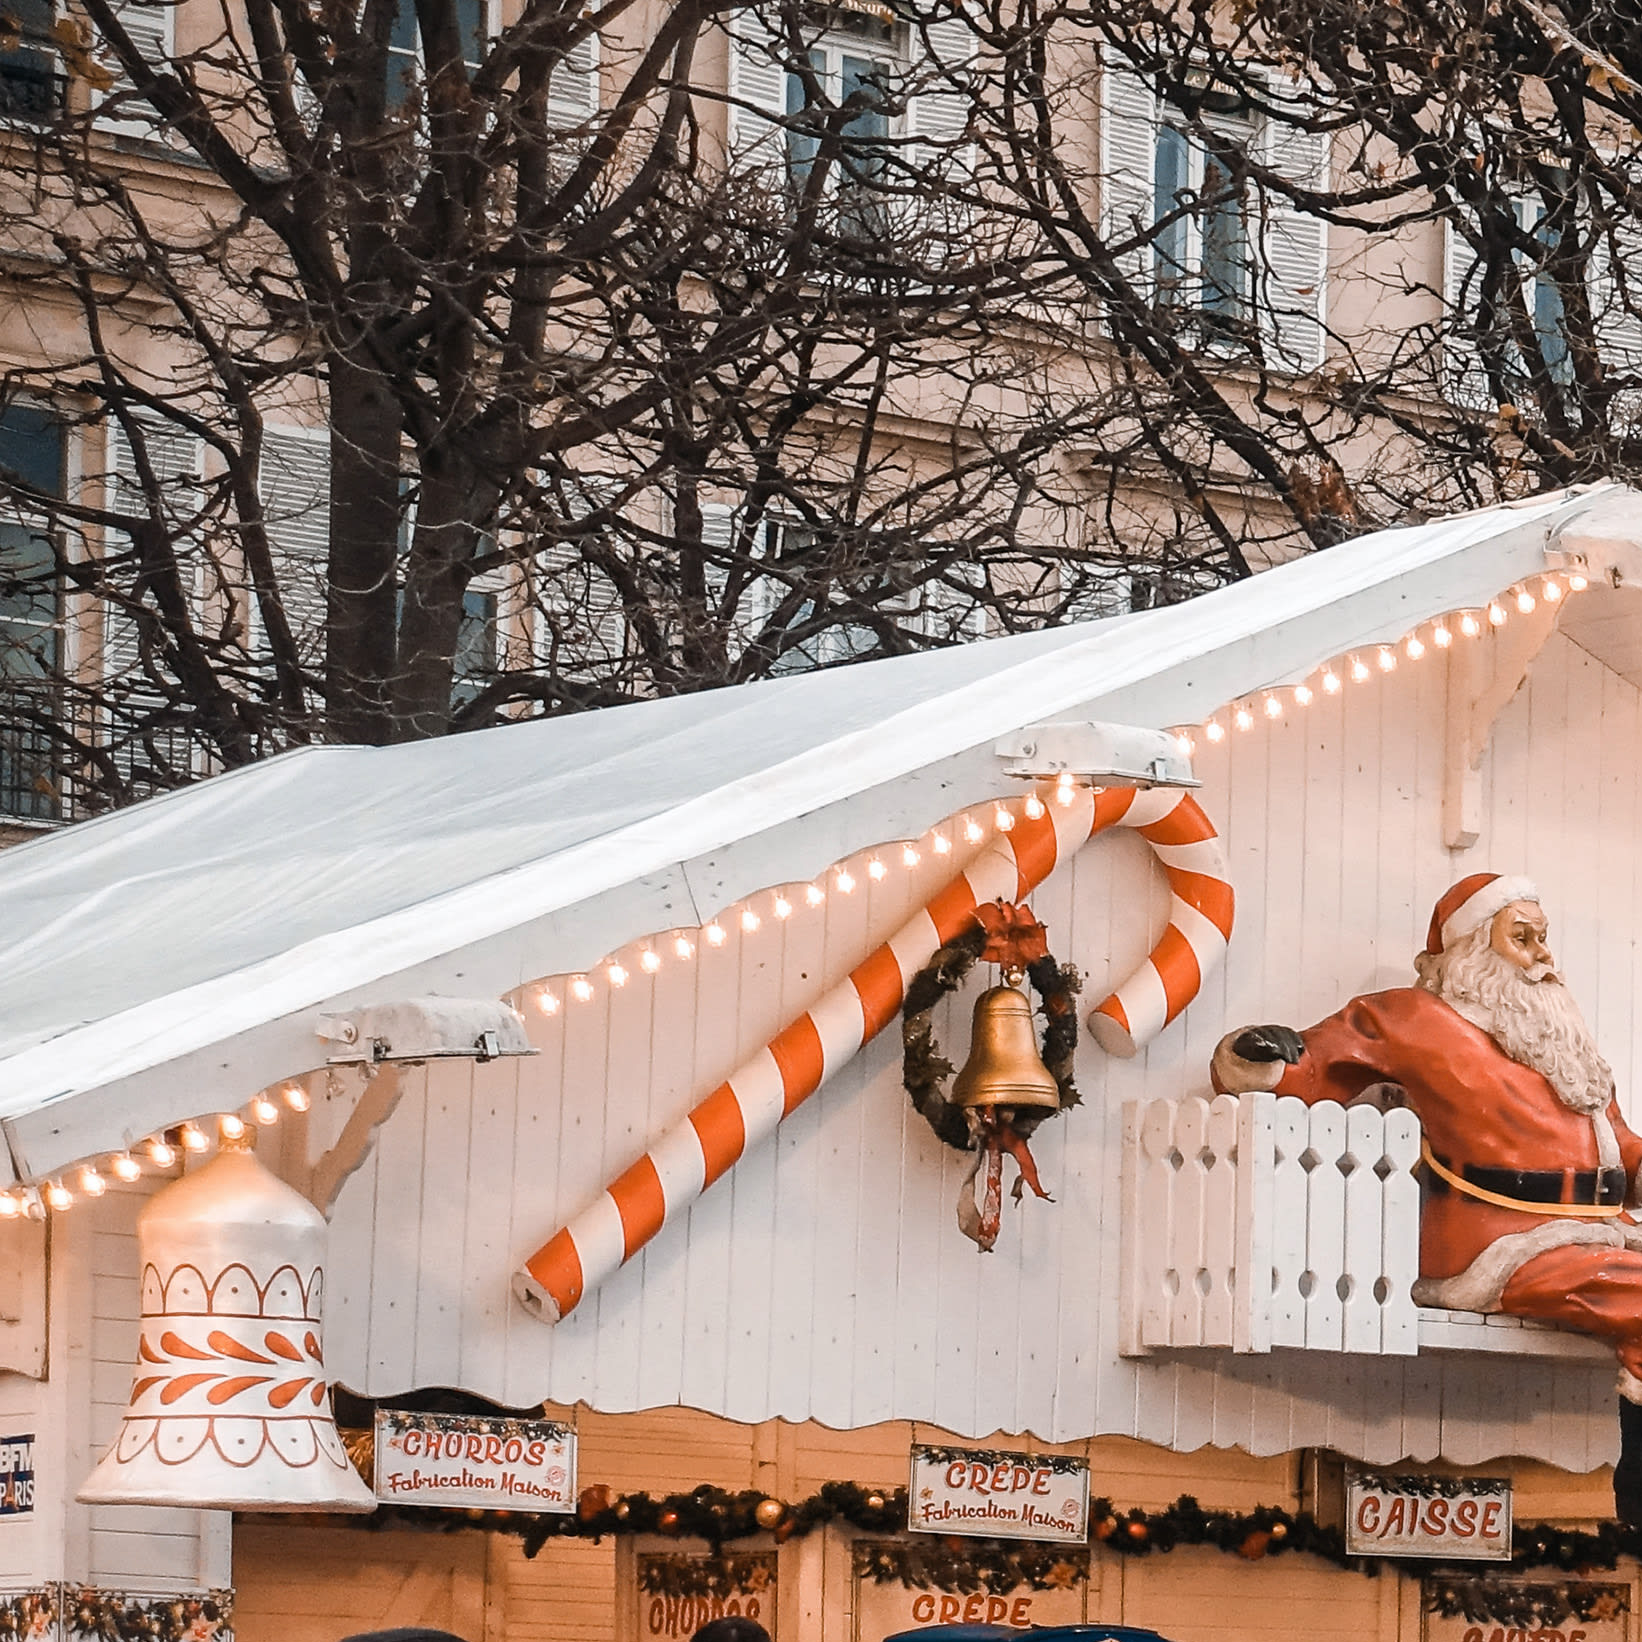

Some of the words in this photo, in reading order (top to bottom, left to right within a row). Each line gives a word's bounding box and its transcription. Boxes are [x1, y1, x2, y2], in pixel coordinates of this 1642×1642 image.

[0, 1440, 33, 1474] BFM
[388, 1467, 495, 1493] Fabrication
[500, 1471, 562, 1501] Maison
[921, 1499, 1017, 1522] Fabrication
[1022, 1503, 1075, 1532] Maison
[1358, 1495, 1502, 1540] CAISSE
